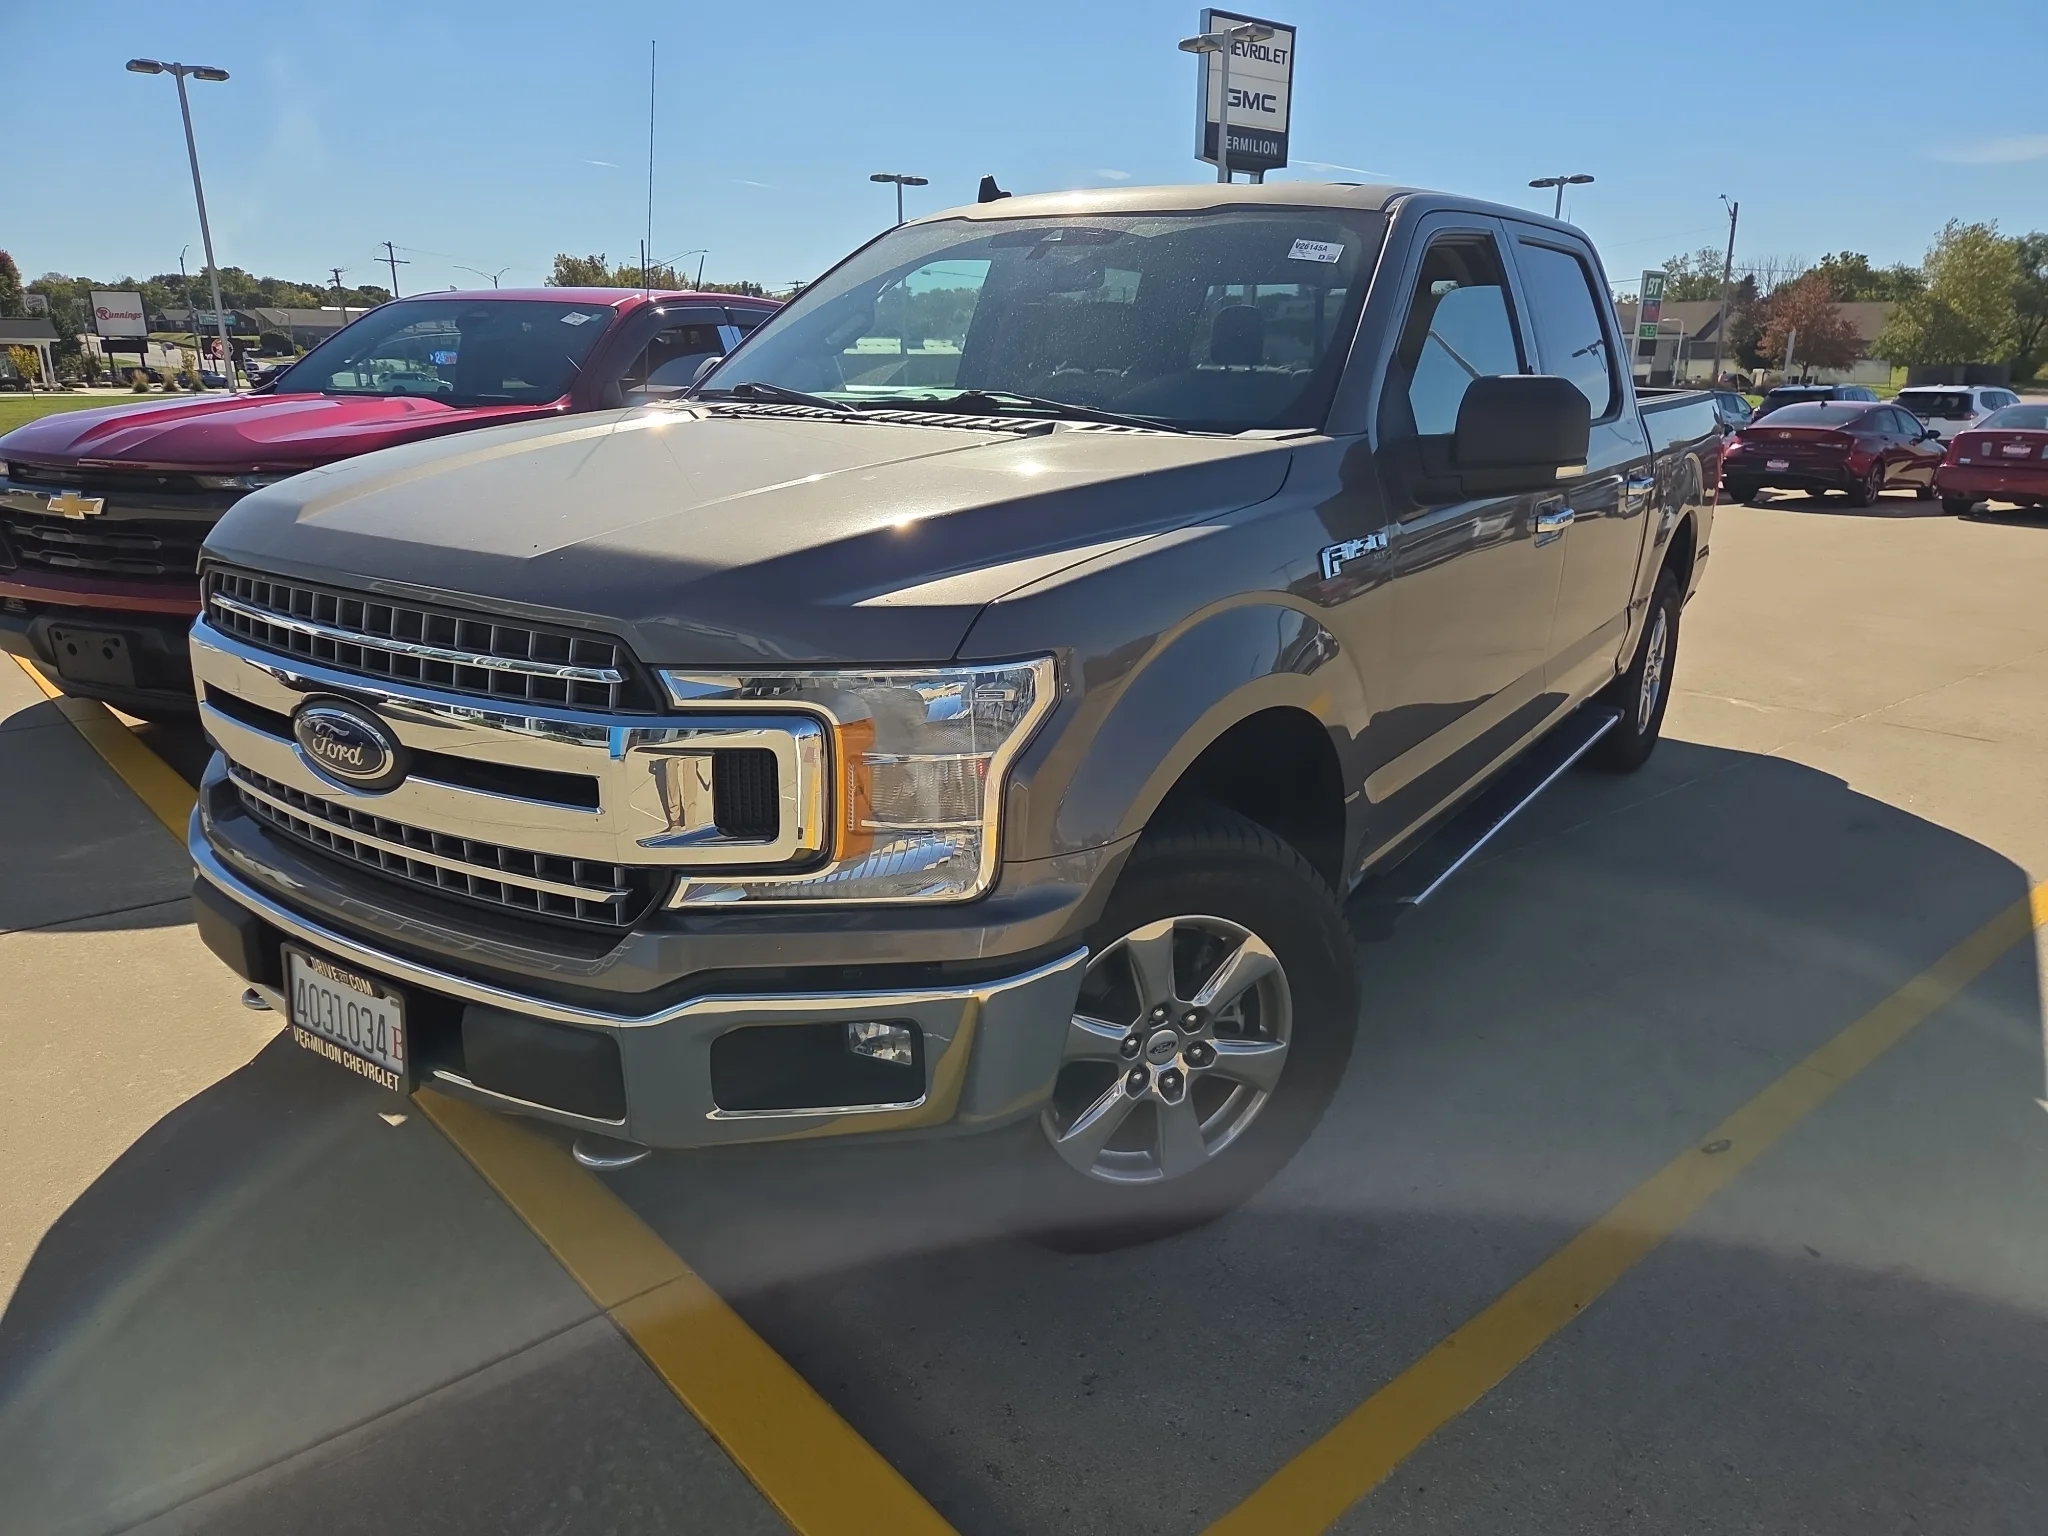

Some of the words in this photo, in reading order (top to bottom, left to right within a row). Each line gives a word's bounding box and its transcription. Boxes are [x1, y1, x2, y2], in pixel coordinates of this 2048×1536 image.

[1227, 88, 1277, 114] GMC
[1225, 135, 1278, 156] ERMILION
[1295, 242, 1328, 252] V26145A
[1646, 277, 1662, 296] BT
[95, 306, 142, 321] Runnings
[312, 721, 364, 766] Ford
[309, 956, 340, 982] DRIVE
[297, 978, 388, 1061] 4031034
[292, 1025, 342, 1064] VERMILION
